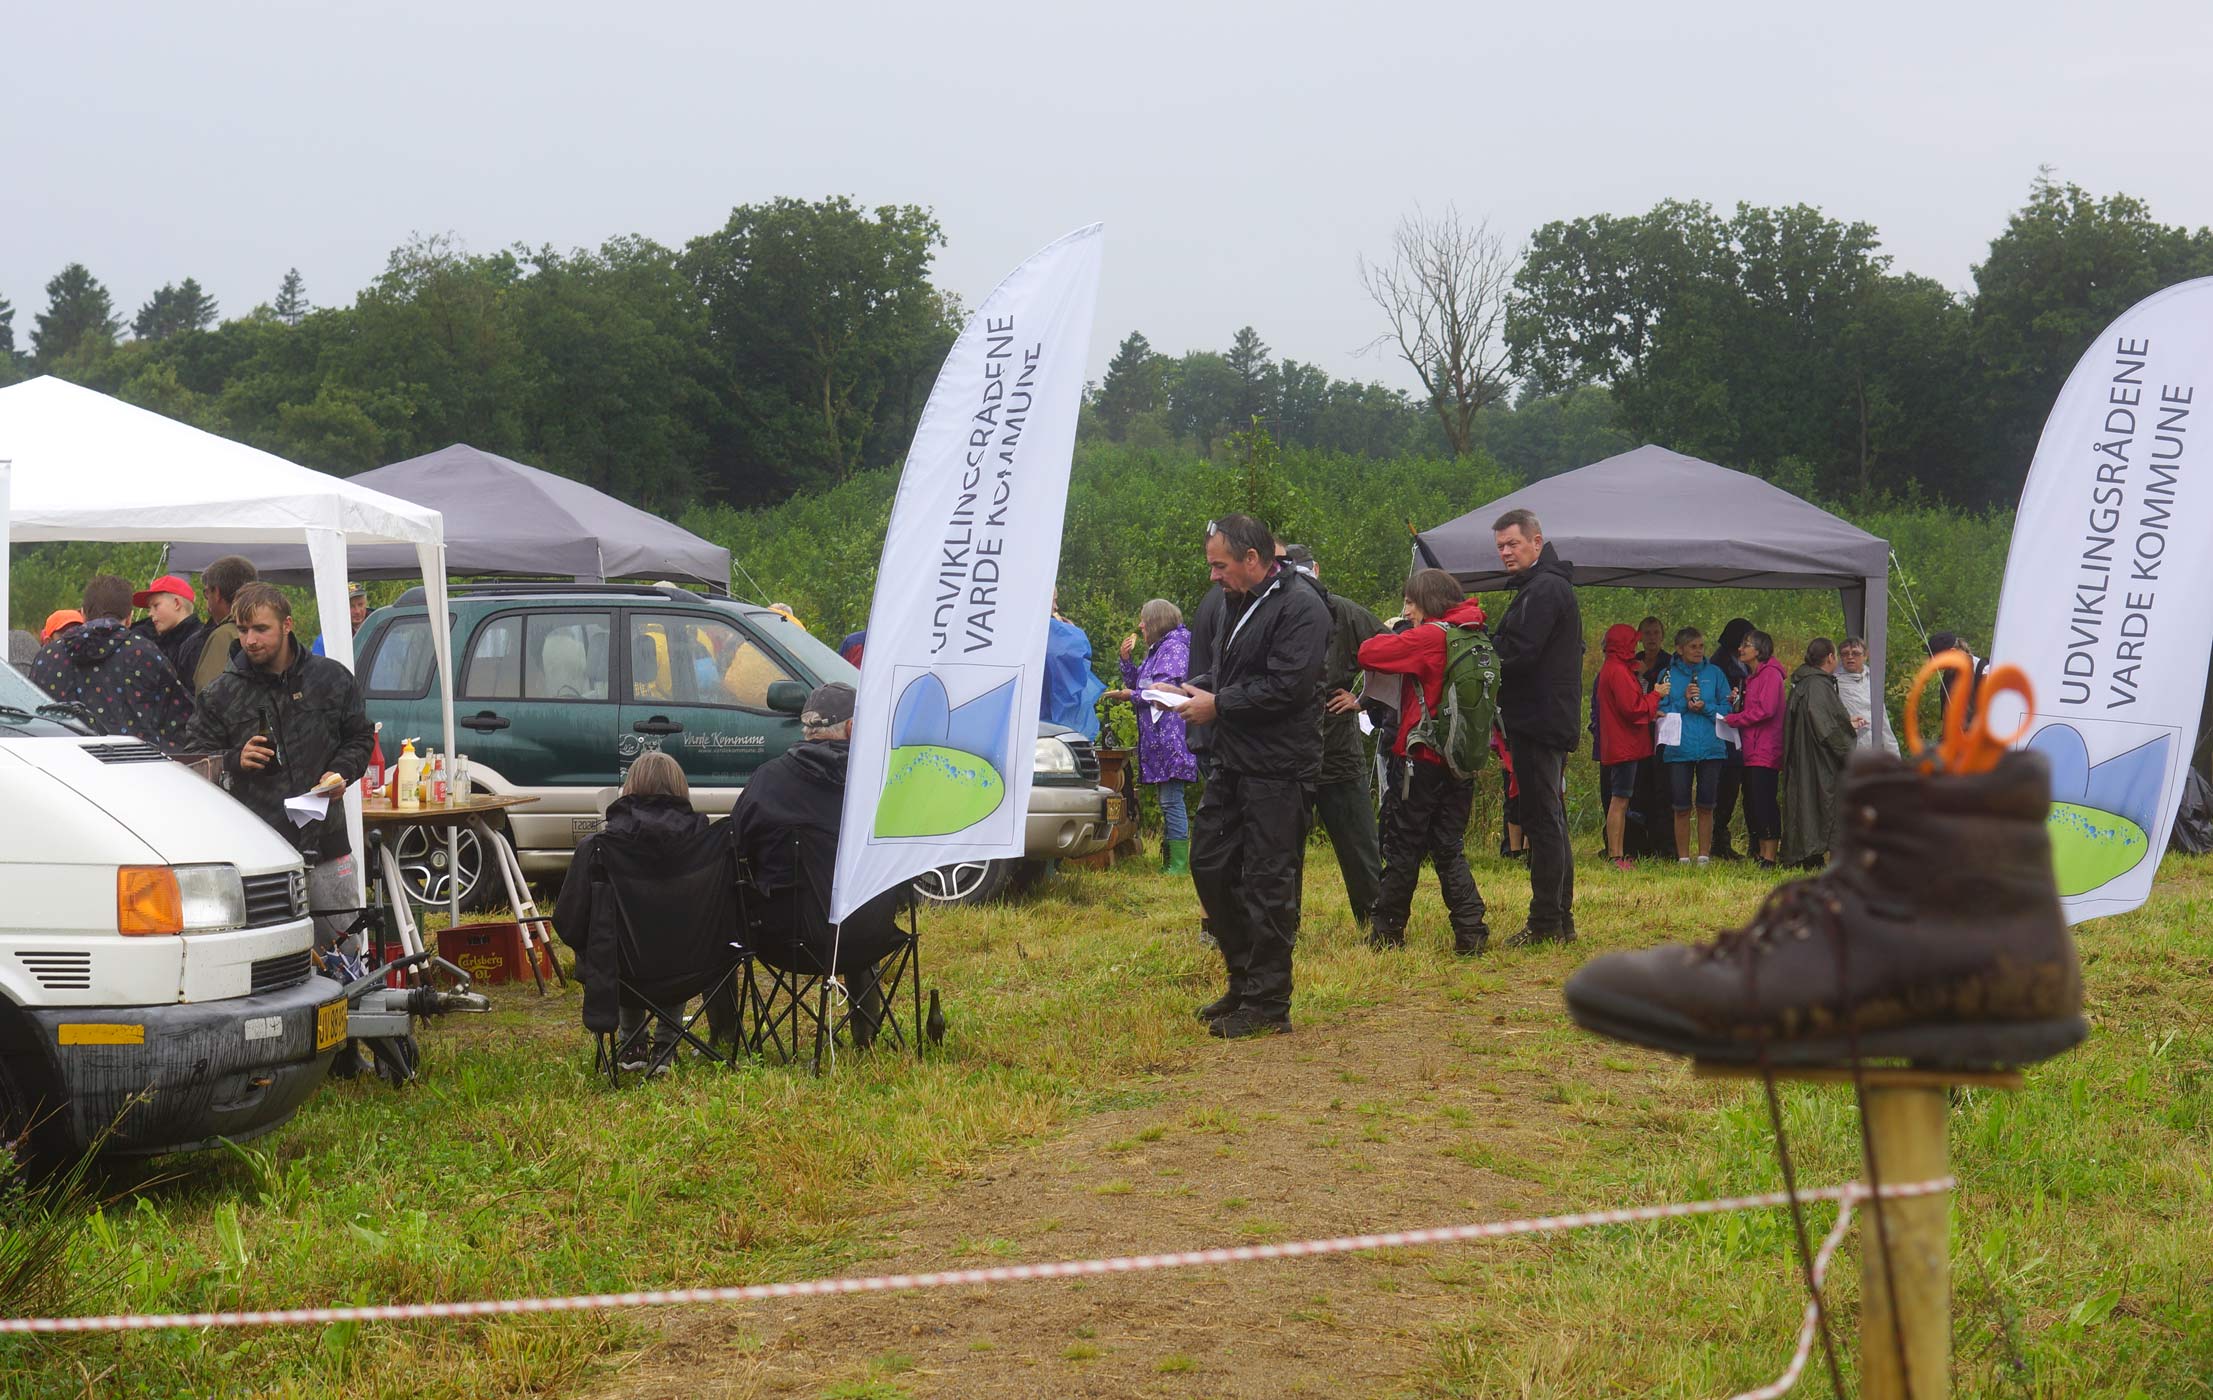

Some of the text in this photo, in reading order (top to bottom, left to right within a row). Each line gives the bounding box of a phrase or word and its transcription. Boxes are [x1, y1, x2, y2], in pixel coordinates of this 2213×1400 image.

[2059, 337, 2149, 705] UDVIKLINGSRÅDENE
[2106, 384, 2194, 709] VARDE KOMMUNE
[964, 537, 1003, 653] VARDE
[711, 731, 765, 747] Kommune
[457, 952, 503, 973] Carlsberg
